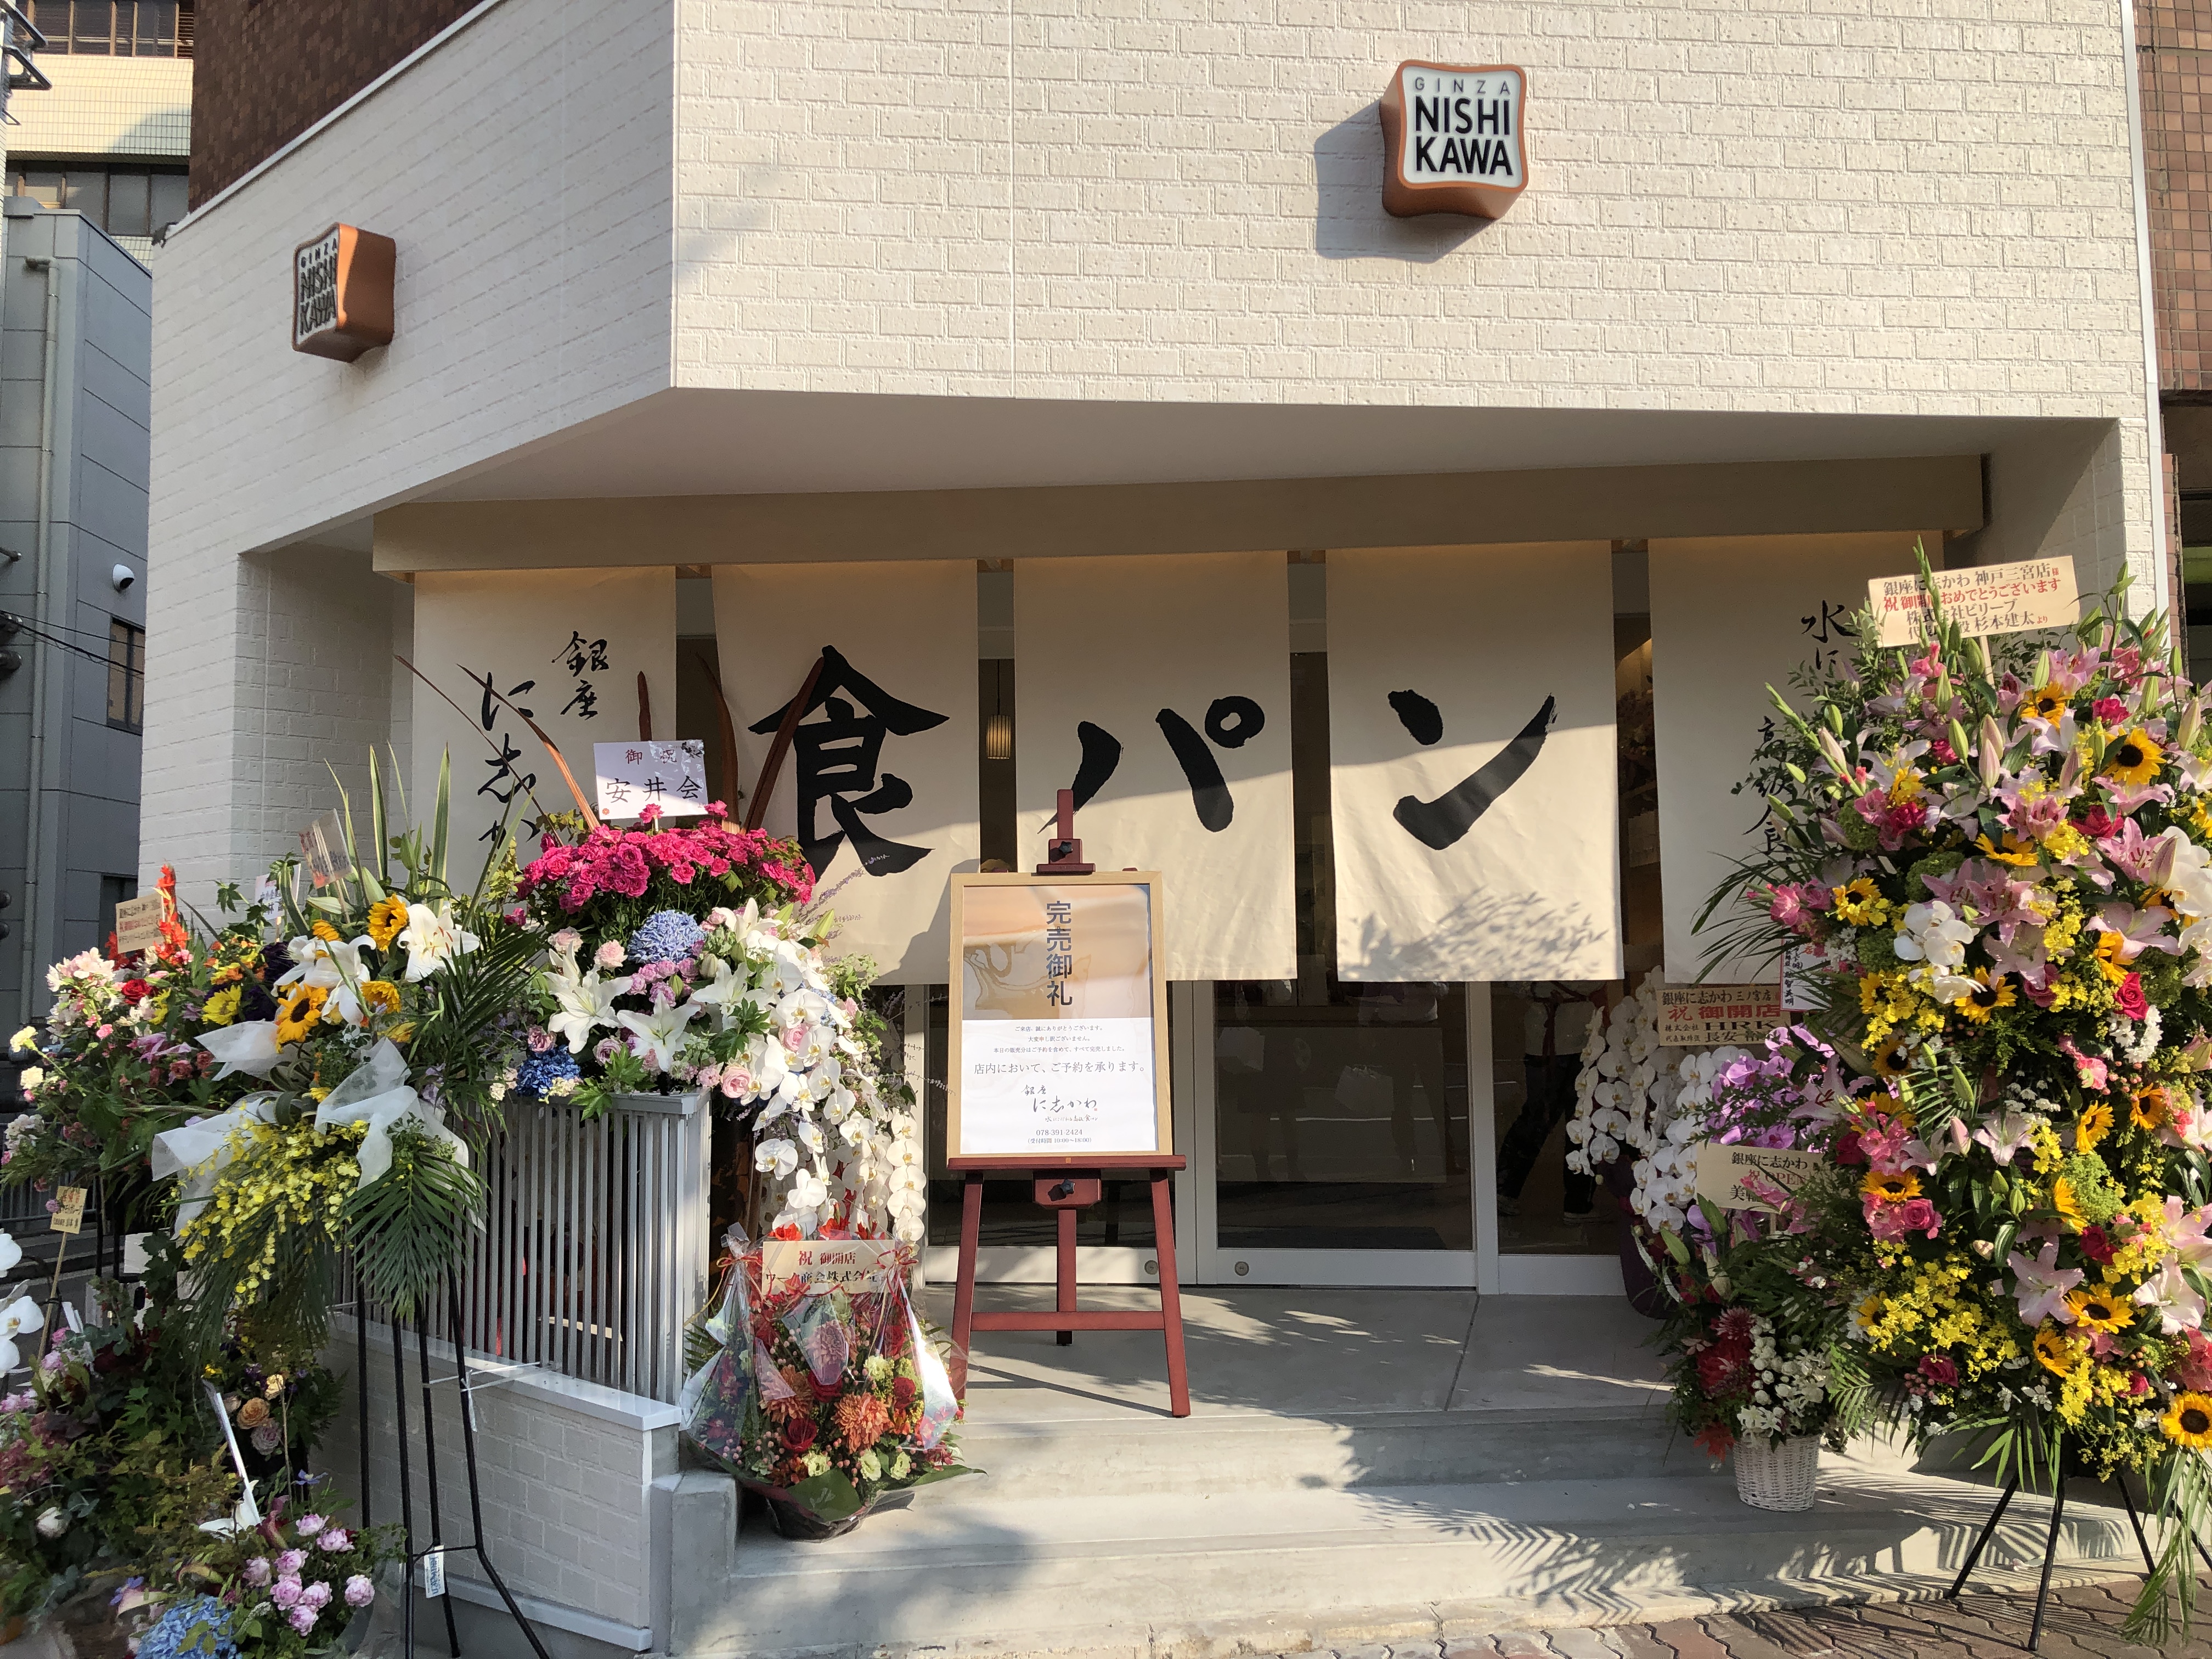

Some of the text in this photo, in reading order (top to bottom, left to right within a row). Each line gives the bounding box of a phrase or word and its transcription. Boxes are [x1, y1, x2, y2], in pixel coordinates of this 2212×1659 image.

[1414, 77, 1511, 94] GINZA
[1415, 95, 1510, 136] NISHI
[1416, 136, 1514, 176] KAWA
[301, 238, 337, 268] GINZA
[301, 252, 337, 302] NISHI
[300, 287, 336, 335] KAWA
[1883, 578, 2061, 612] 祝 御開おめでとうございます
[551, 631, 610, 720] 銀座
[477, 671, 541, 856] に志か
[605, 775, 703, 804] 安井会
[1046, 900, 1073, 1007] 完売御礼
[1662, 989, 1779, 1006] 銀座に志かわ 三ノ宮店
[1664, 1020, 1778, 1032] 株式会社 HRK
[1667, 1004, 1781, 1023] 祝 御開店
[974, 1061, 1144, 1075] 店内において、ご予約を承ります。
[1021, 1084, 1047, 1096] 銀座
[1033, 1095, 1097, 1113] に志かわ
[1731, 1152, 1808, 1170] 銀座に志かわ
[798, 1250, 856, 1266] 祝 御開店
